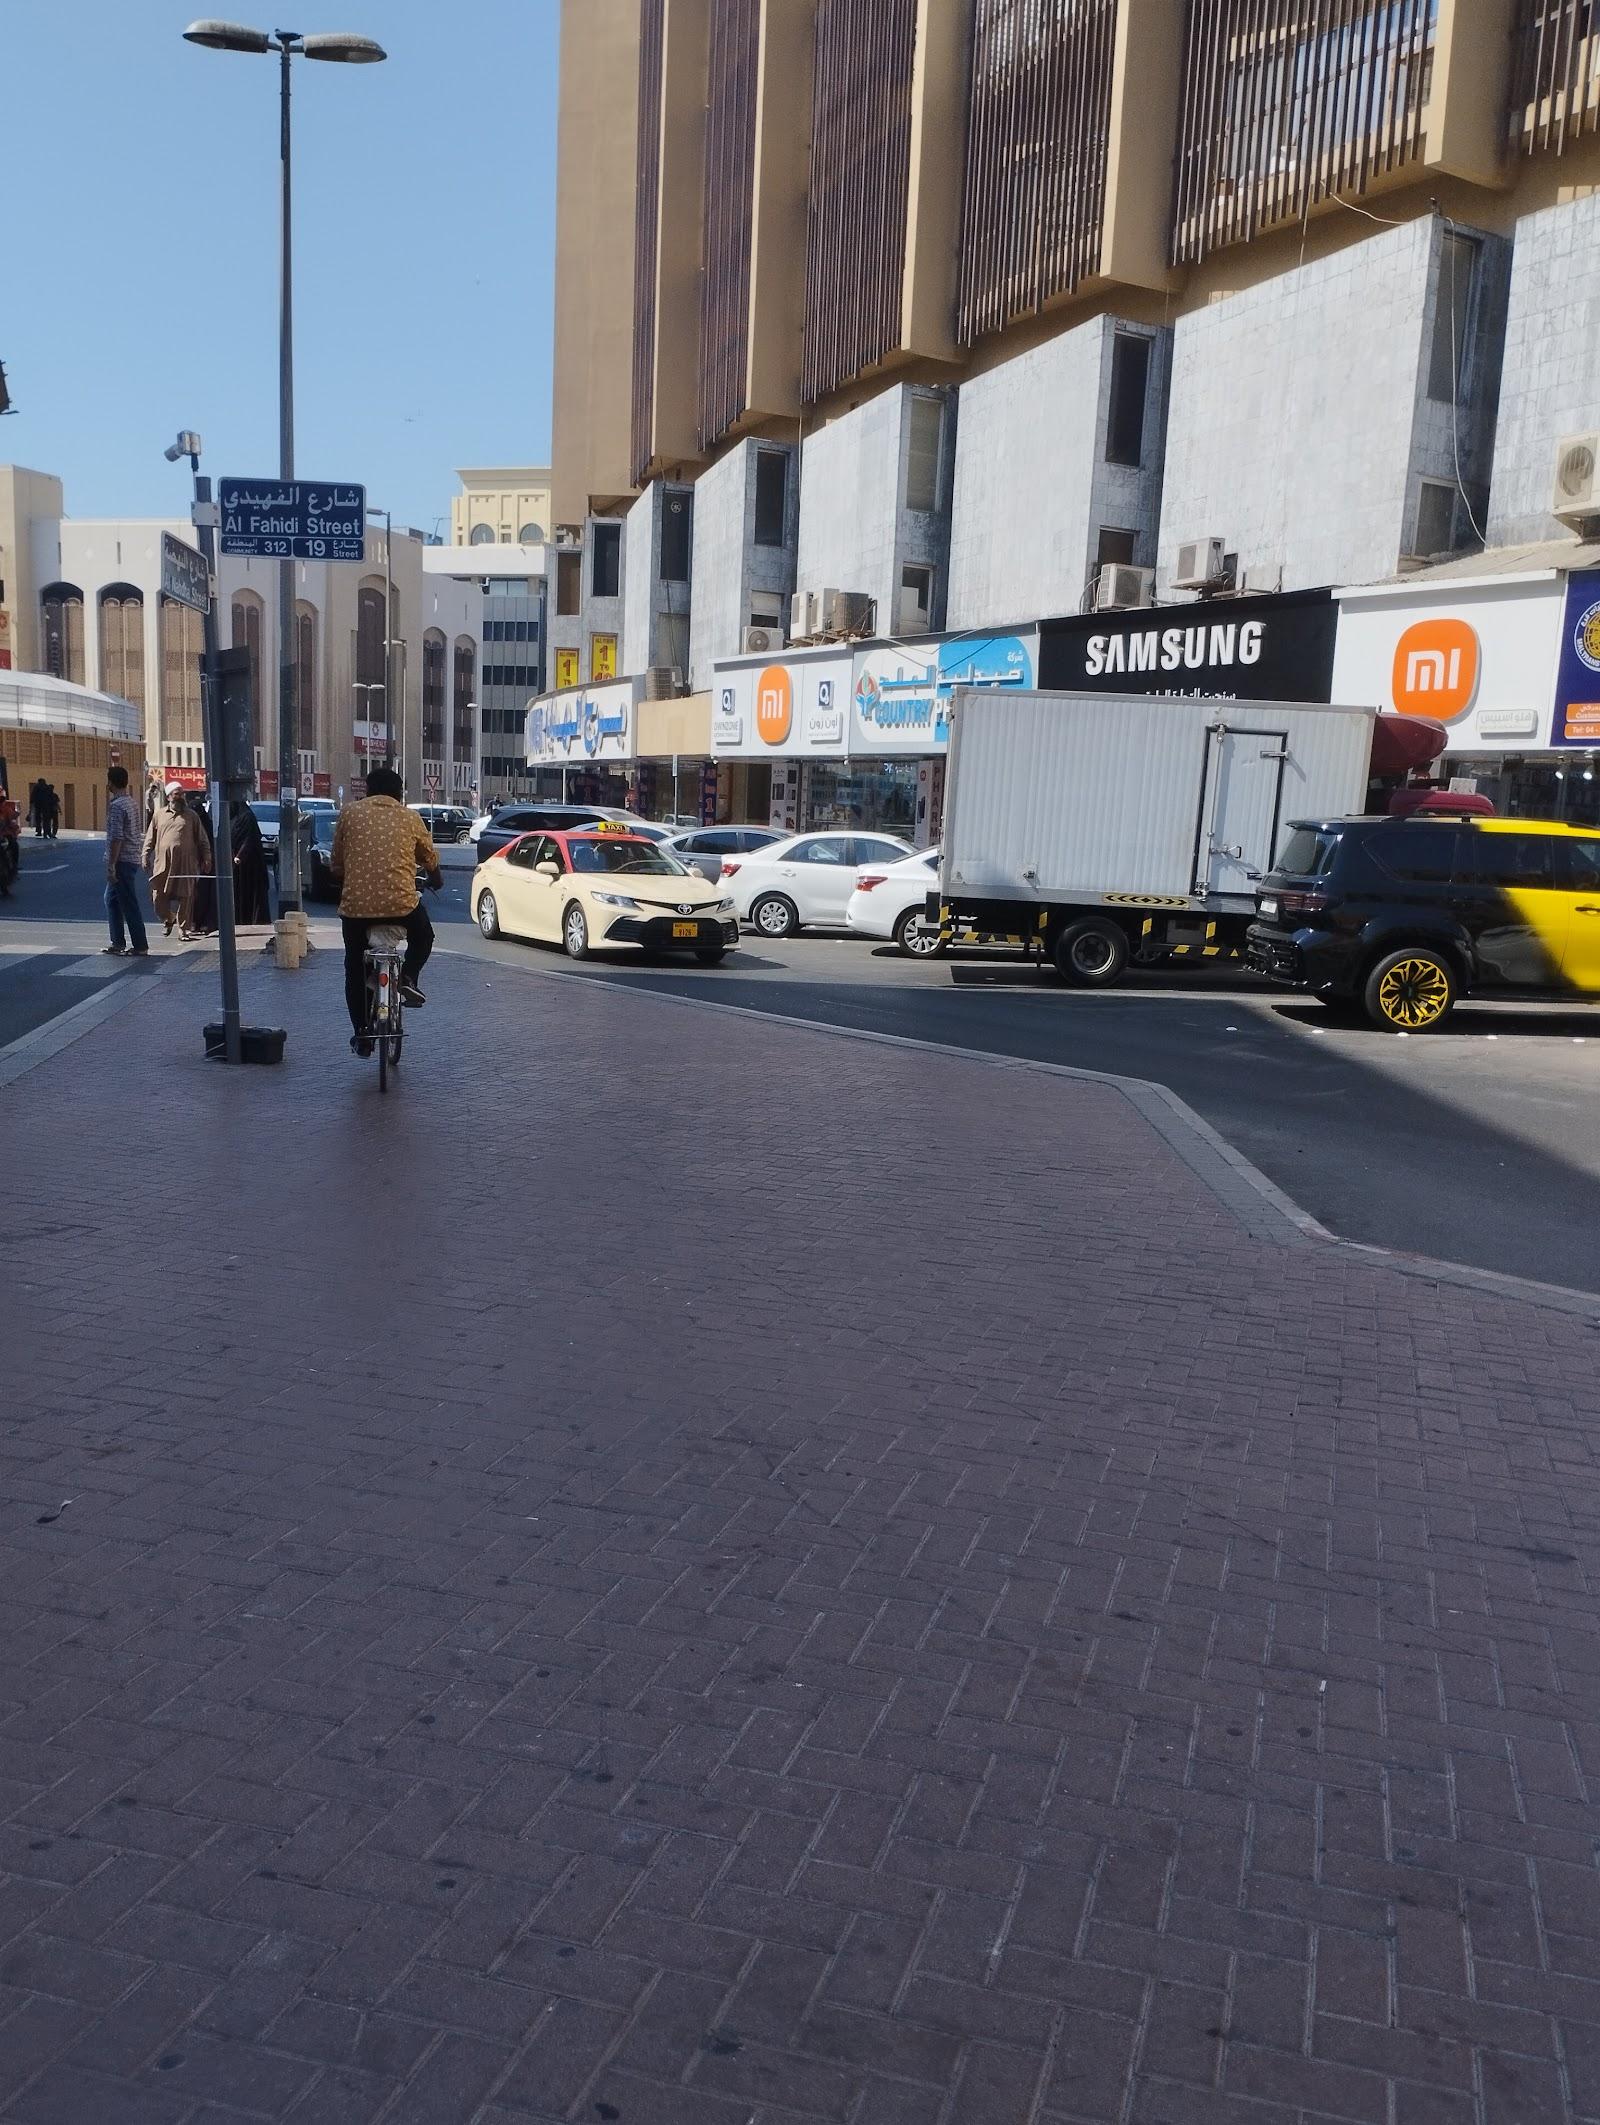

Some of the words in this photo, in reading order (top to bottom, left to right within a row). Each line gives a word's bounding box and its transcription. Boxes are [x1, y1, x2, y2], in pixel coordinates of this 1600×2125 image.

[224, 486, 300, 513] الفهيدي
[307, 487, 359, 514] شارع
[225, 516, 242, 532] Al
[250, 516, 299, 534] Fahidi
[307, 517, 361, 535] Street
[264, 541, 287, 553] 312
[305, 540, 326, 556] 19
[333, 539, 359, 549] شارع
[333, 550, 359, 558] Street
[599, 645, 608, 661] 1
[1085, 621, 1263, 676] SAMSUNG
[563, 659, 571, 677] 1
[875, 699, 932, 726] COUNTRY
[606, 823, 627, 832] TAXI
